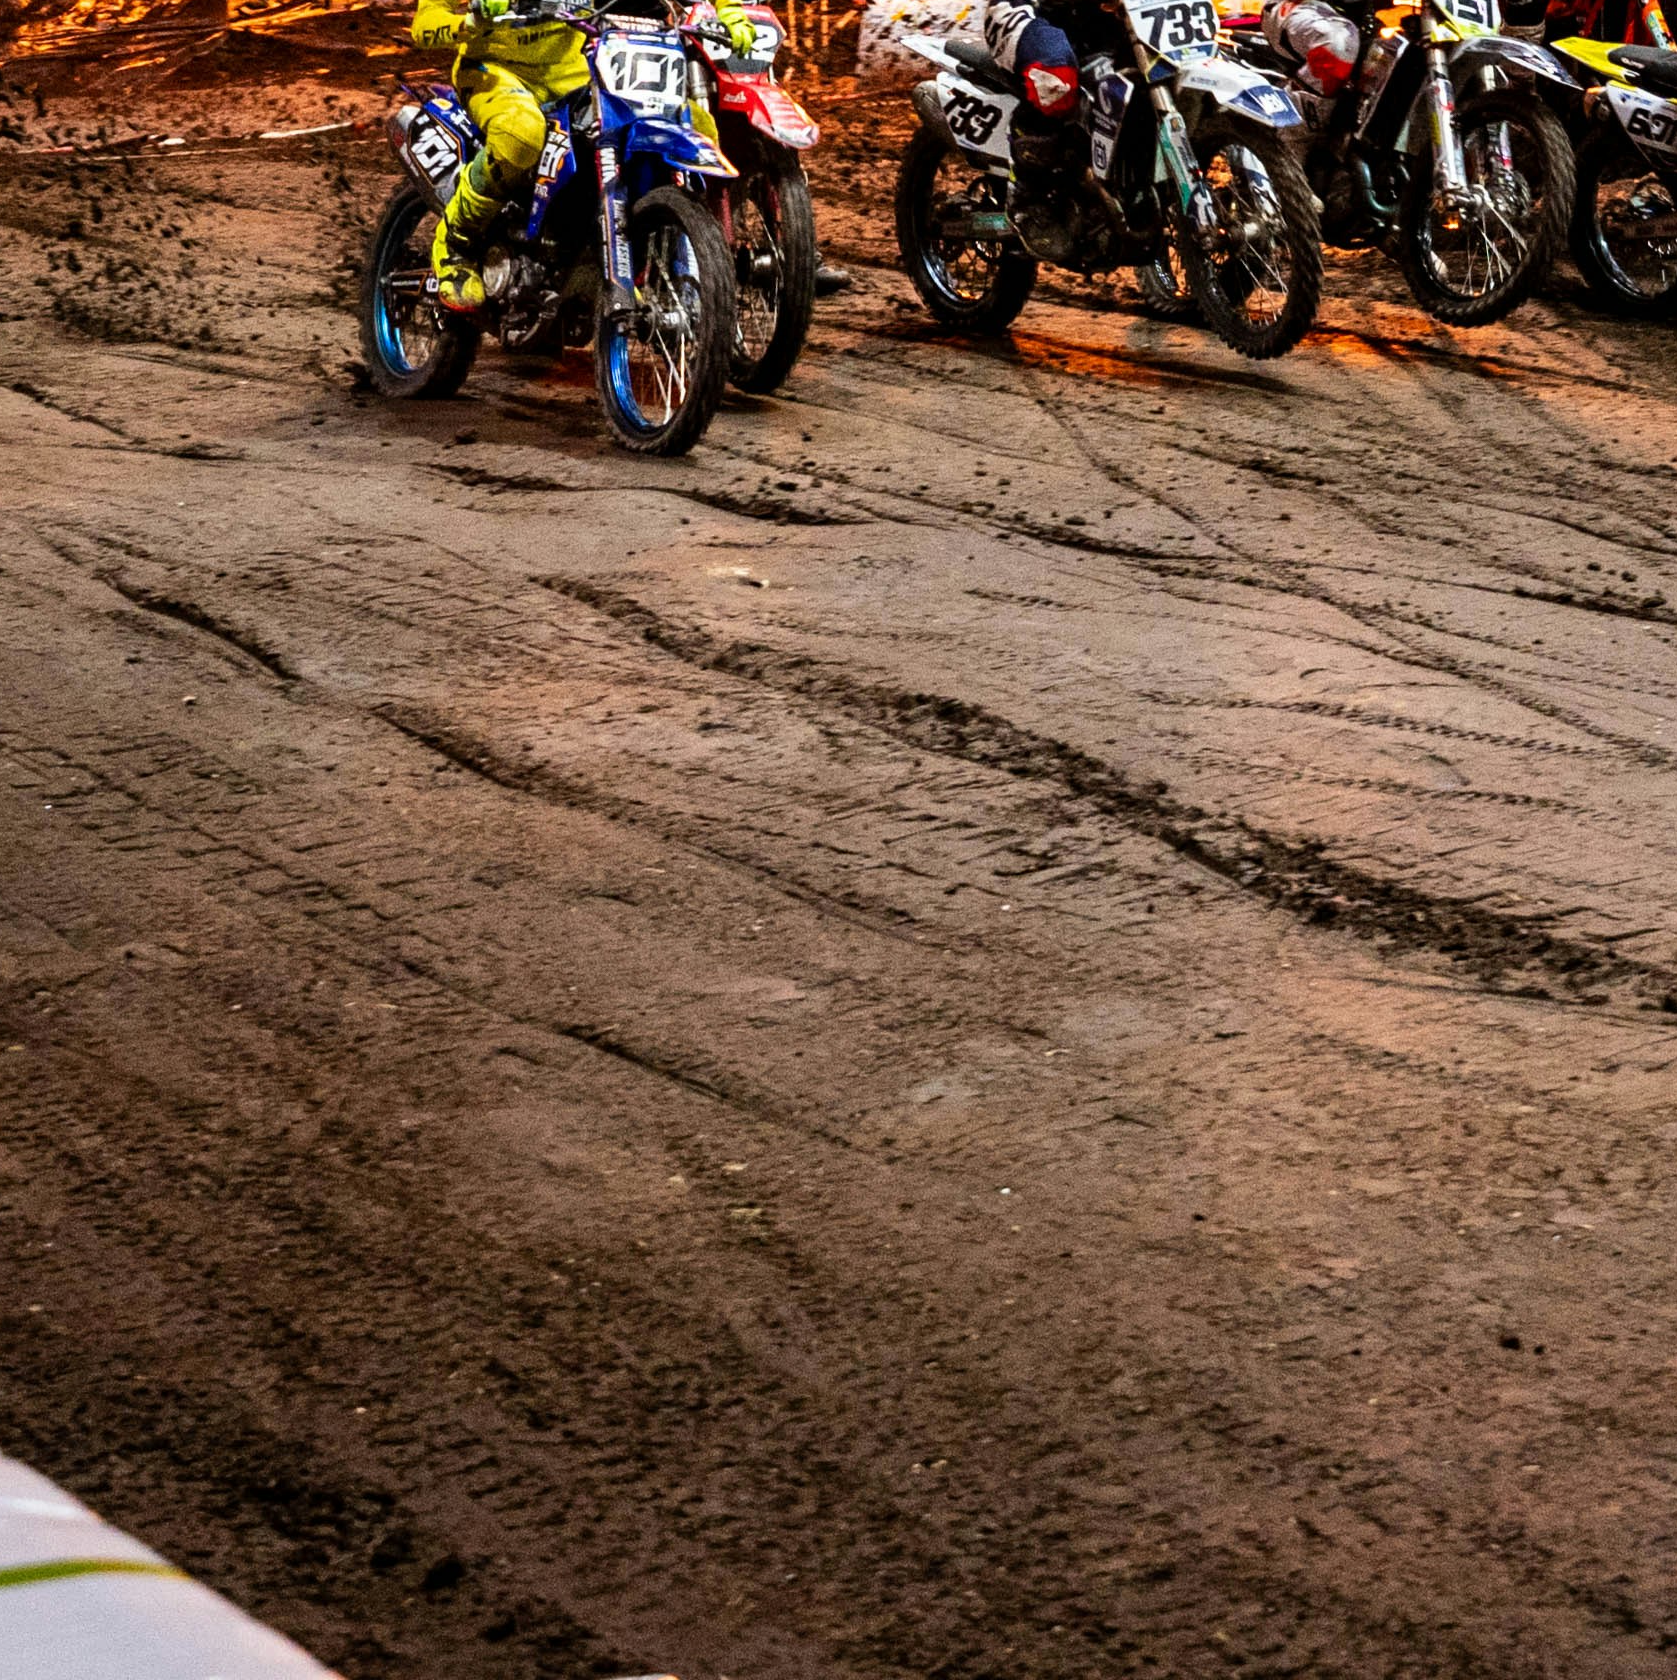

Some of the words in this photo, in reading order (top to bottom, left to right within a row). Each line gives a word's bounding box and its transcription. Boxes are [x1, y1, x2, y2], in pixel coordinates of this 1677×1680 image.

[422, 28, 453, 47] FXR
[1139, 0, 1218, 51] 733
[610, 50, 685, 97] 101
